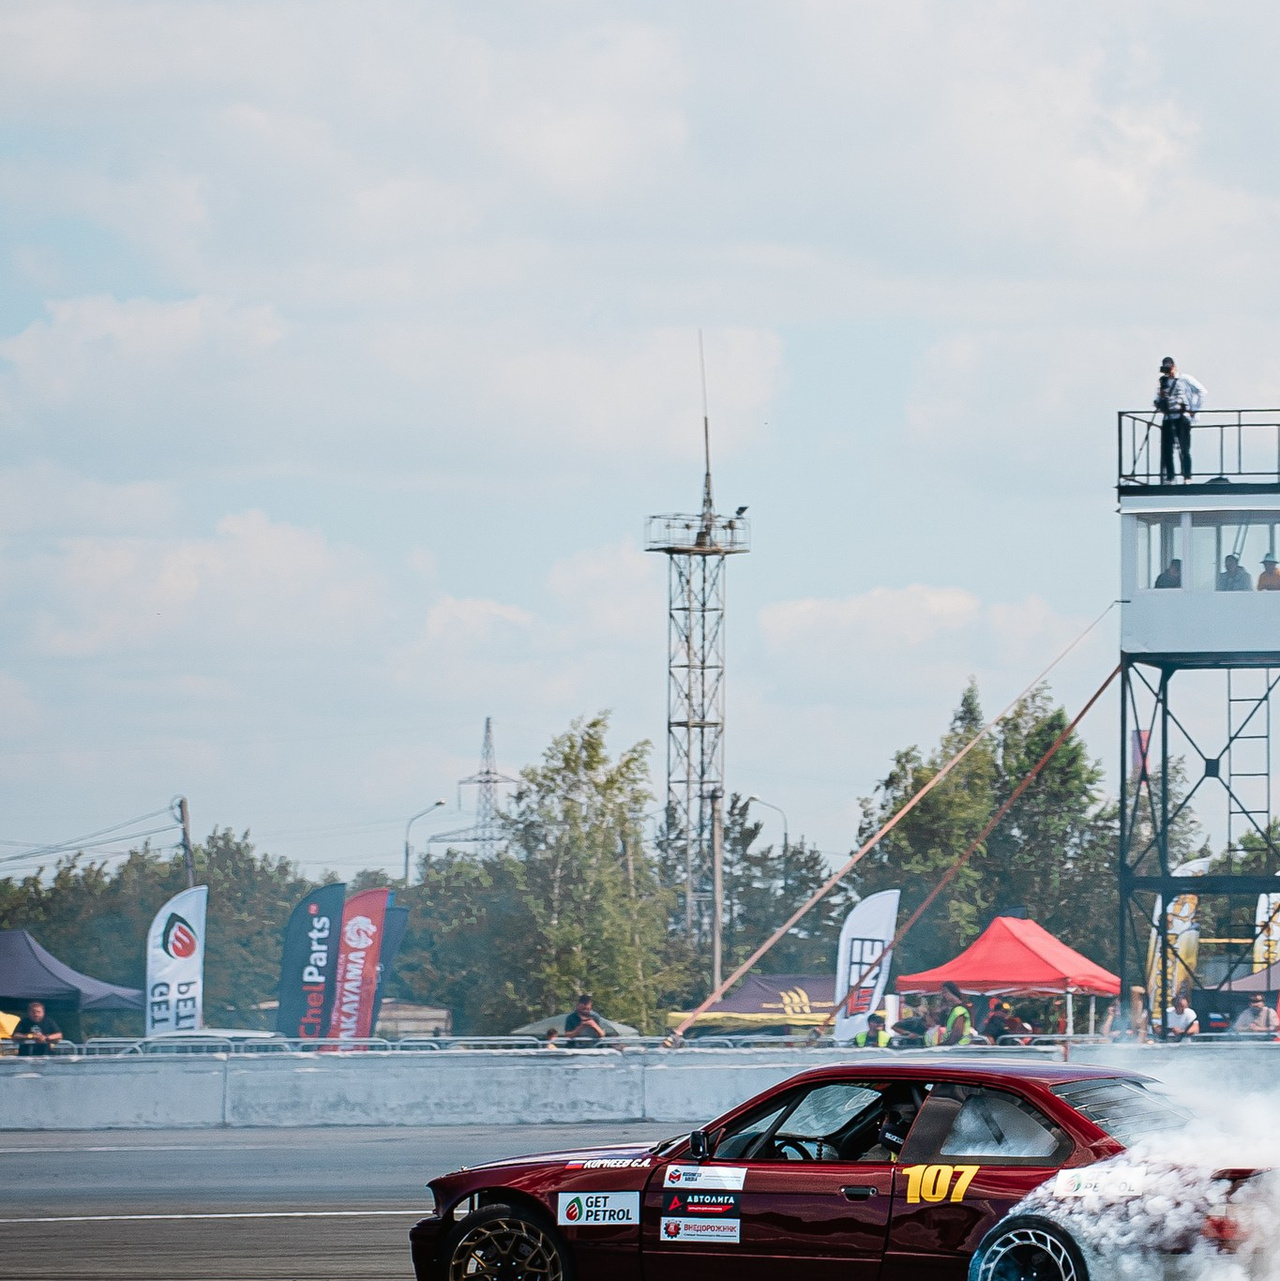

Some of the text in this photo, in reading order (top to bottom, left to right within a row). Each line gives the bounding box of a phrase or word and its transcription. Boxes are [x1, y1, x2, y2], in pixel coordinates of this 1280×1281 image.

[902, 1165, 980, 1204] 107
[585, 1196, 609, 1208] GET
[686, 1195, 735, 1204] АВТОЛИГА
[585, 1209, 632, 1222] PETROL
[683, 1224, 737, 1233] ВНЕДОРОЖНИК
